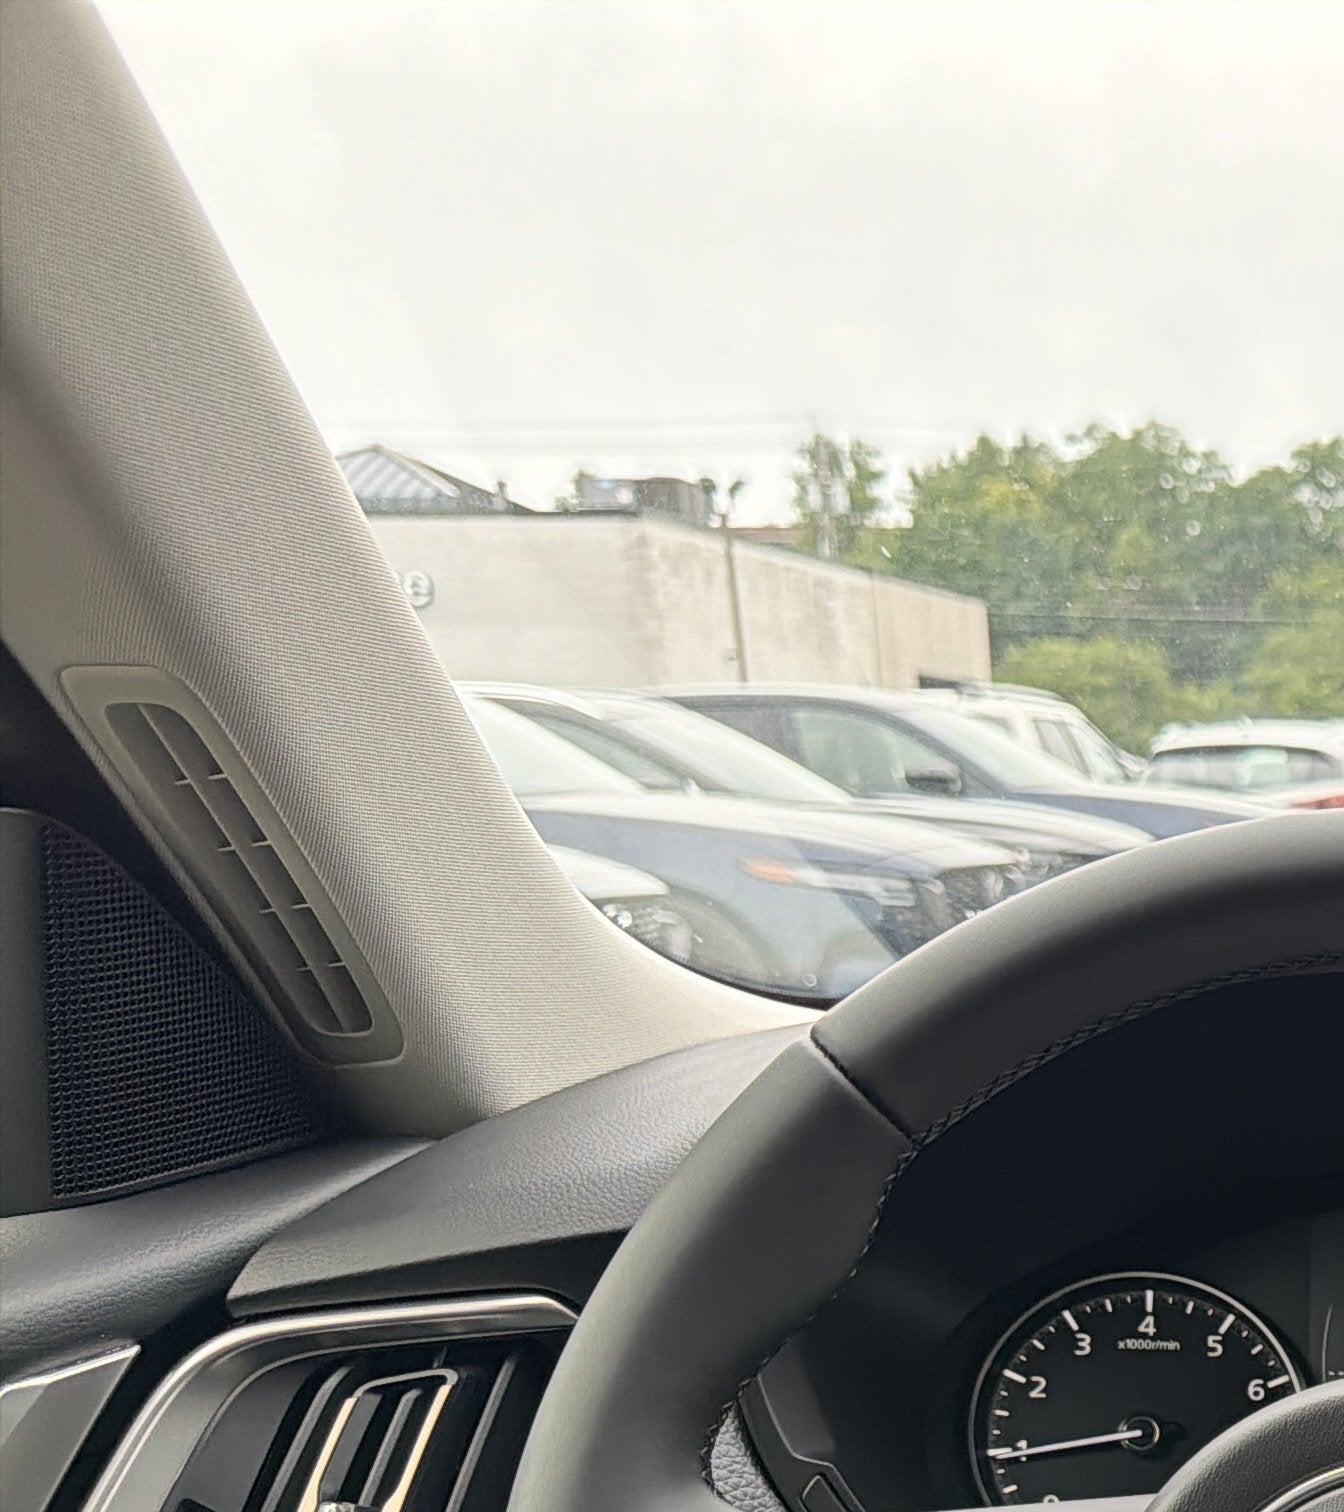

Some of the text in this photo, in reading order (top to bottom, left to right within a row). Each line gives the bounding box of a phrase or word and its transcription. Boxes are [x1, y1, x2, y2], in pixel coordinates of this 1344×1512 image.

[1137, 1315, 1157, 1337] 4
[1074, 1333, 1092, 1357] 3
[1206, 1335, 1224, 1358] 5
[1030, 1376, 1047, 1400] 2
[1247, 1378, 1265, 1402] 6
